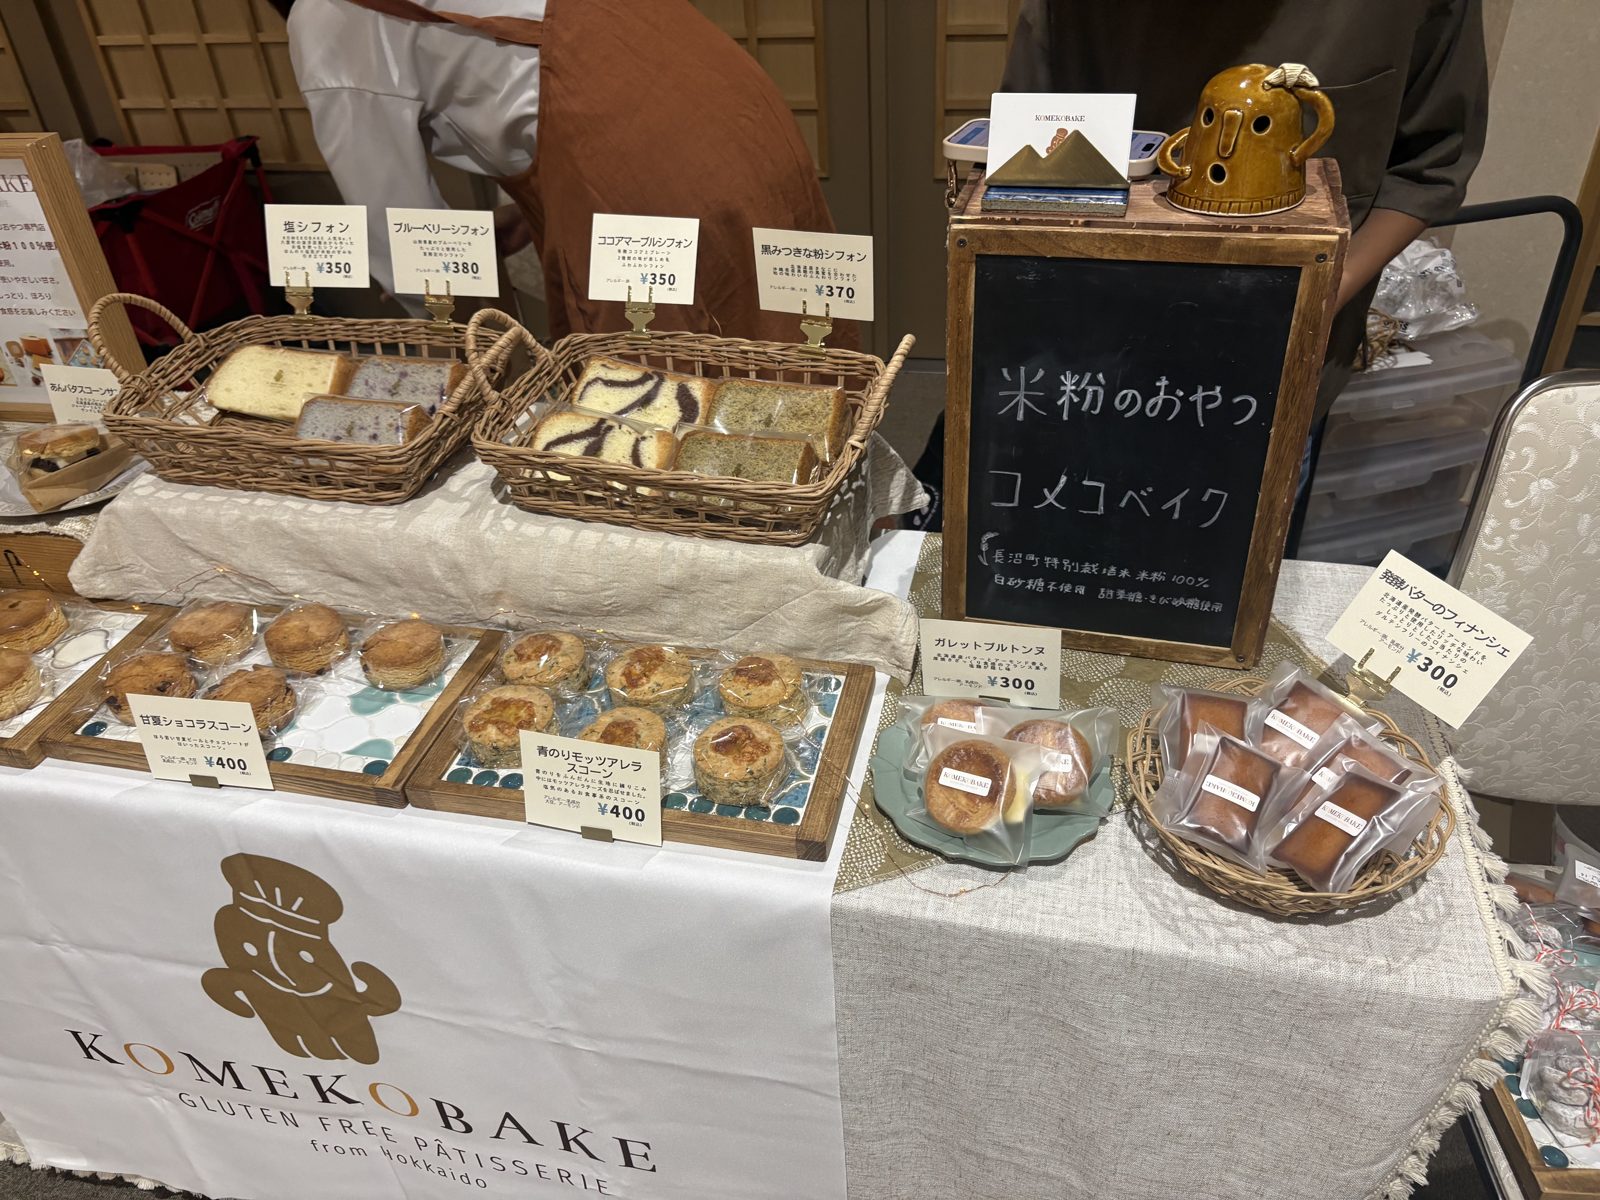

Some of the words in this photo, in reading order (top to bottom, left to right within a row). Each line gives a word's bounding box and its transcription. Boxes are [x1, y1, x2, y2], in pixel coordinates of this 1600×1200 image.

[283, 220, 350, 233] 塩シフォン
[393, 222, 490, 236] ブルーベリーシフォン
[598, 236, 693, 249] ココアマーブルシフォン
[760, 244, 867, 262] 黒みつきな粉シフォン
[316, 262, 352, 274] ¥350
[442, 261, 480, 274] ¥380
[640, 273, 676, 286] ¥350
[815, 285, 855, 299] ¥370
[997, 366, 1257, 427] 米粉のおやつ
[988, 469, 1228, 528] コメコベイク
[994, 573, 1086, 595] 白砂糖不使用
[1171, 575, 1211, 588] 100%
[1379, 568, 1511, 658] 発酵バターのフィナンシェ
[934, 638, 1045, 655] ガレットブルトンヌ
[1375, 610, 1468, 674] グルテンフリーのフィナンシェ
[1406, 648, 1458, 689] ¥300
[987, 676, 1035, 690] ¥300
[139, 714, 252, 733] 甘夏ショコラスコーン
[204, 756, 247, 770] ¥400
[537, 745, 642, 772] 青のりモッツアレラ
[567, 763, 613, 779] スコーン
[598, 802, 646, 822] ¥400
[64, 1029, 657, 1173] KOMEKOBAKE
[178, 1092, 300, 1128] GLUTEN
[318, 1117, 398, 1144] FREE
[414, 1138, 611, 1195] PÂTISSERIE
[310, 1140, 369, 1157] from
[381, 1146, 488, 1189] Hokkaido
